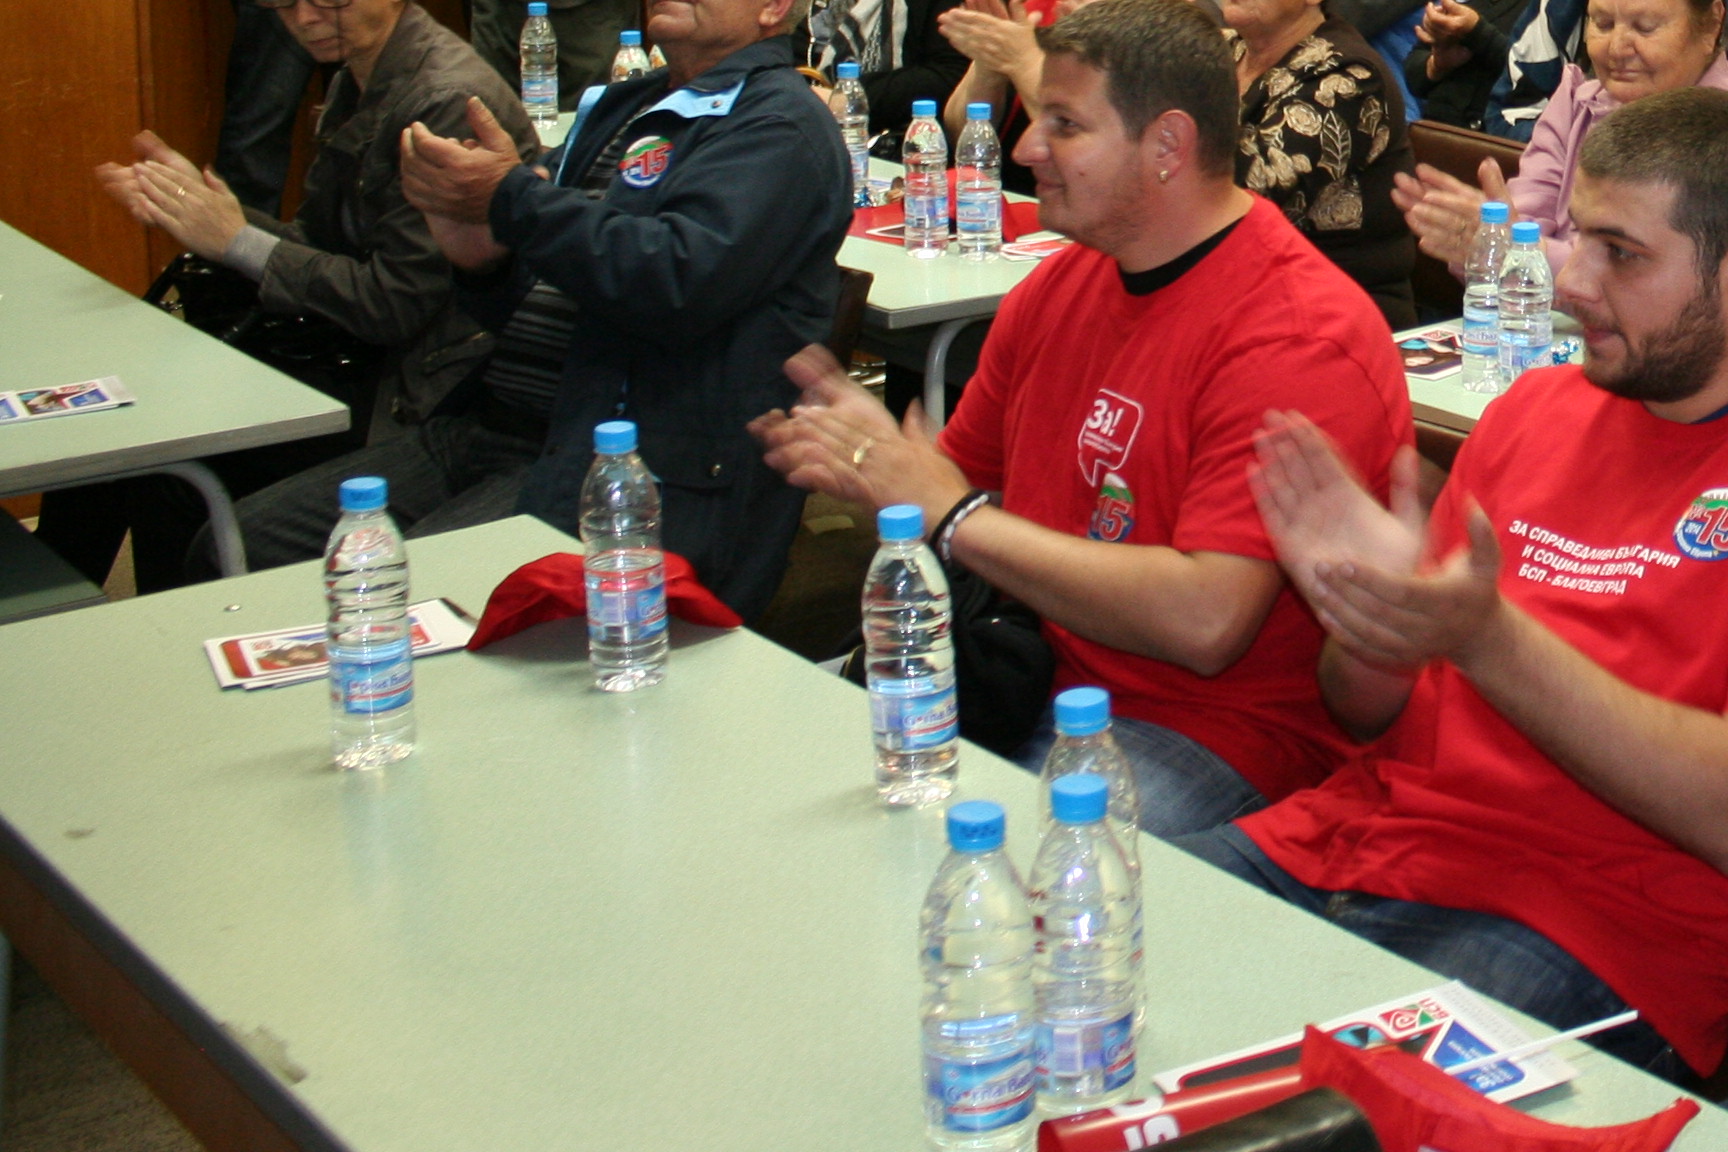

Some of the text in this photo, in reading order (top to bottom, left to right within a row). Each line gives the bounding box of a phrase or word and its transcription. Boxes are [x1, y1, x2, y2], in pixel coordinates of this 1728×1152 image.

[1509, 520, 1528, 537] ЗА
[1522, 544, 1535, 559] И
[1518, 563, 1549, 583] БСП
